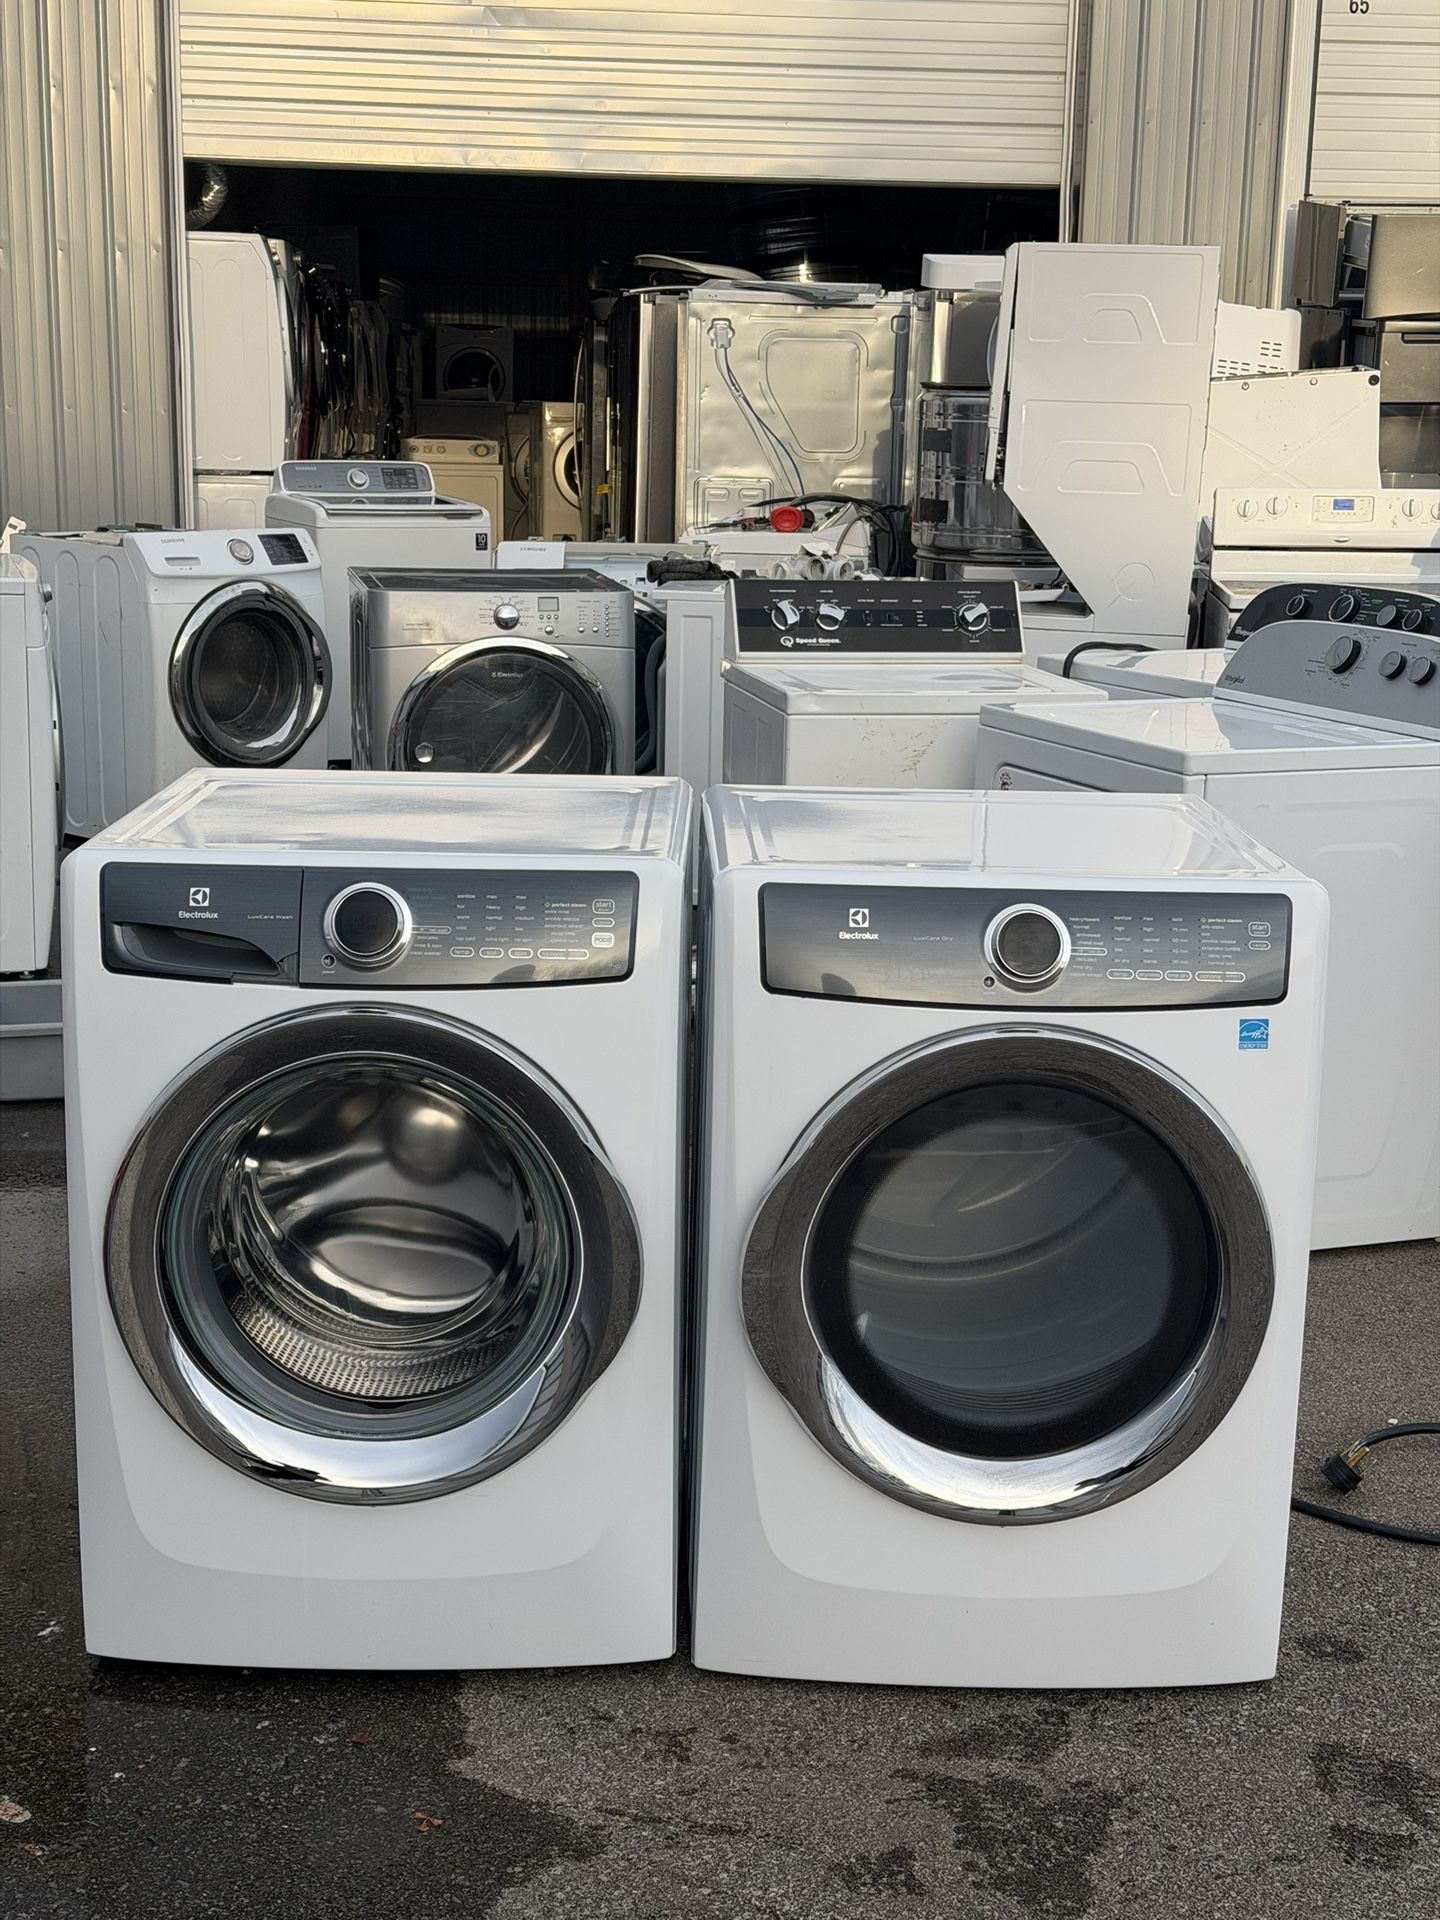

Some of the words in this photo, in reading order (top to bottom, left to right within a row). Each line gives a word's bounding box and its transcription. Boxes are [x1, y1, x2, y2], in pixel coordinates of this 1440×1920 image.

[1349, 0, 1369, 14] 65
[178, 911, 218, 919] Electrolux
[839, 931, 879, 940] Electrolux
